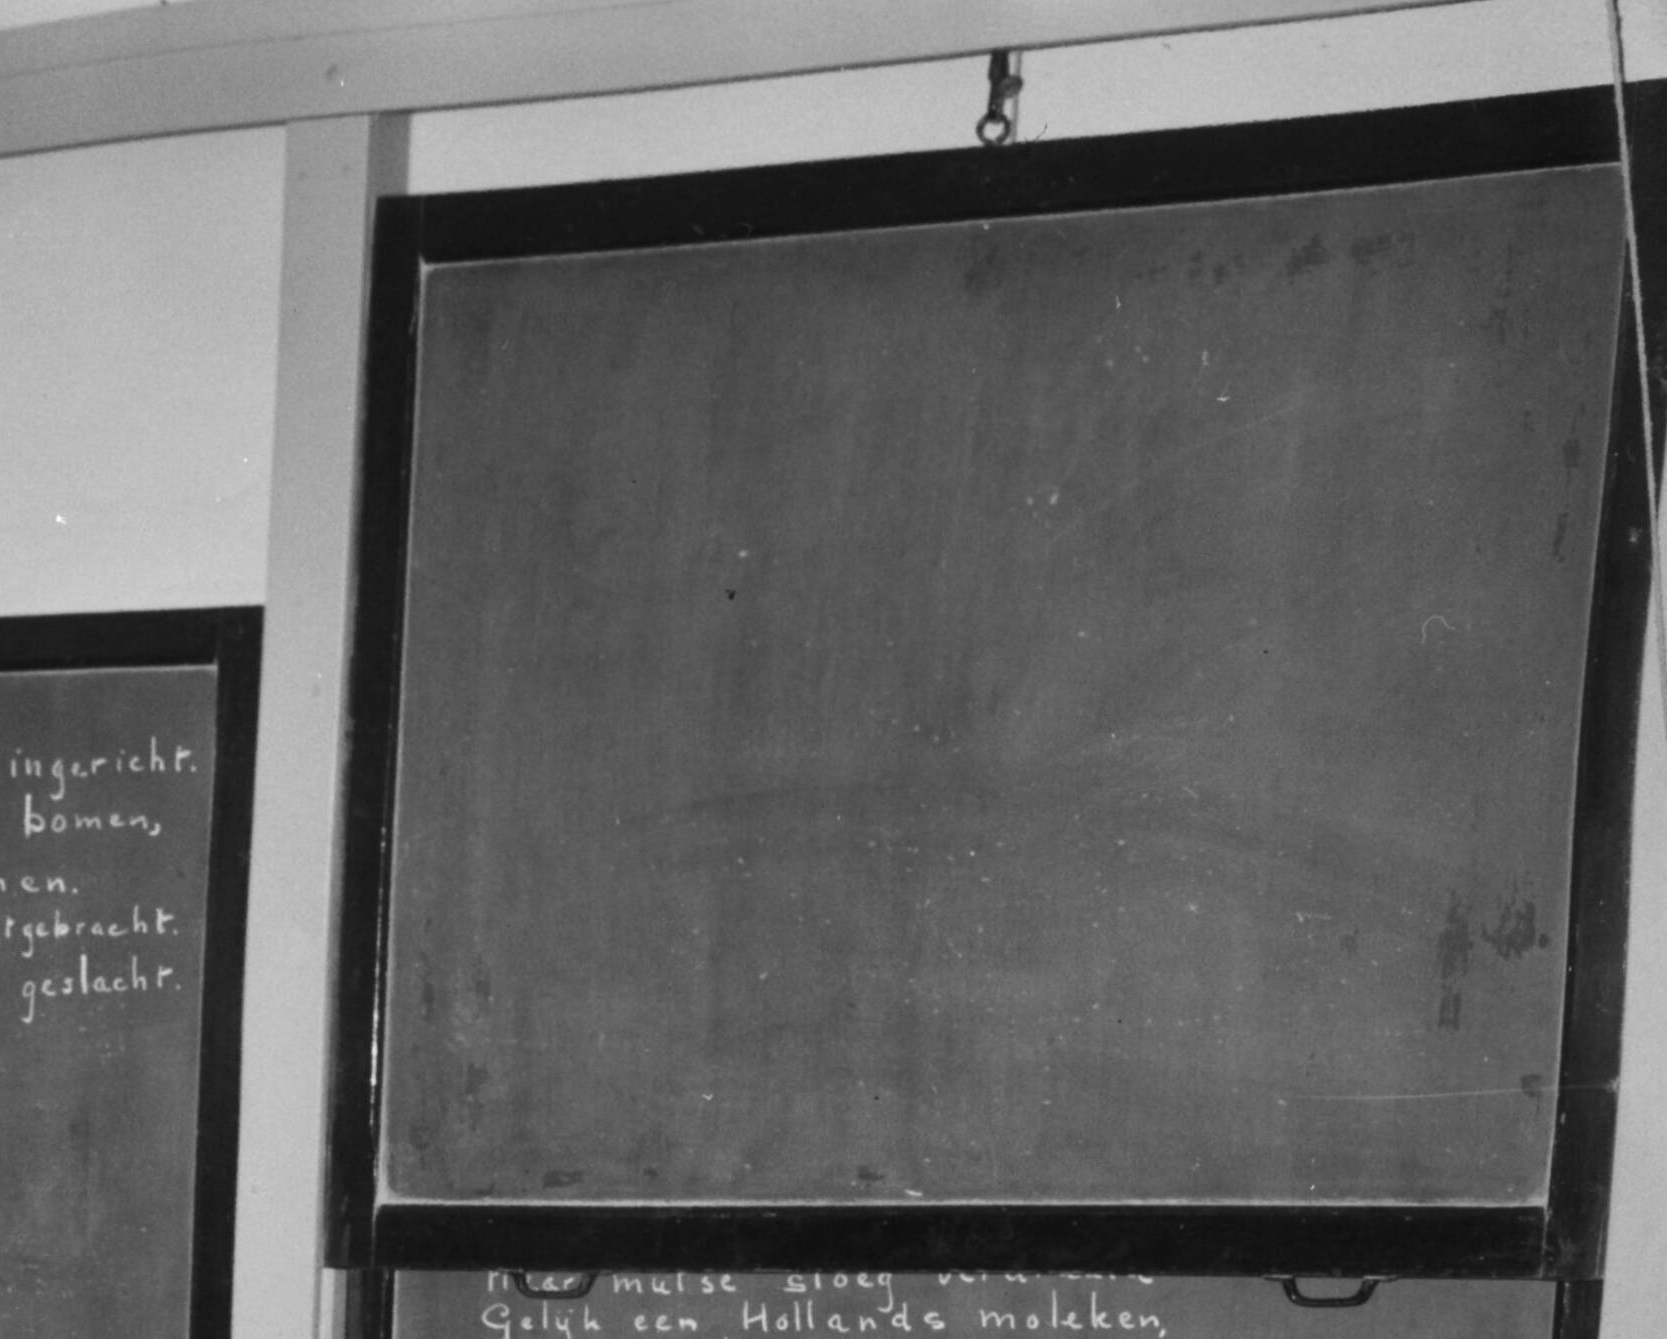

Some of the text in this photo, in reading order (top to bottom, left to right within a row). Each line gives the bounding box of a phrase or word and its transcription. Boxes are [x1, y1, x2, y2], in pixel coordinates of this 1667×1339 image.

[11, 735, 197, 800] ingericht.
[24, 793, 161, 838] bomen,
[21, 953, 182, 1024] geslacht.
[634, 1313, 698, 1331] een
[742, 1300, 946, 1332] Hollands
[979, 1289, 1166, 1339] moleken,
